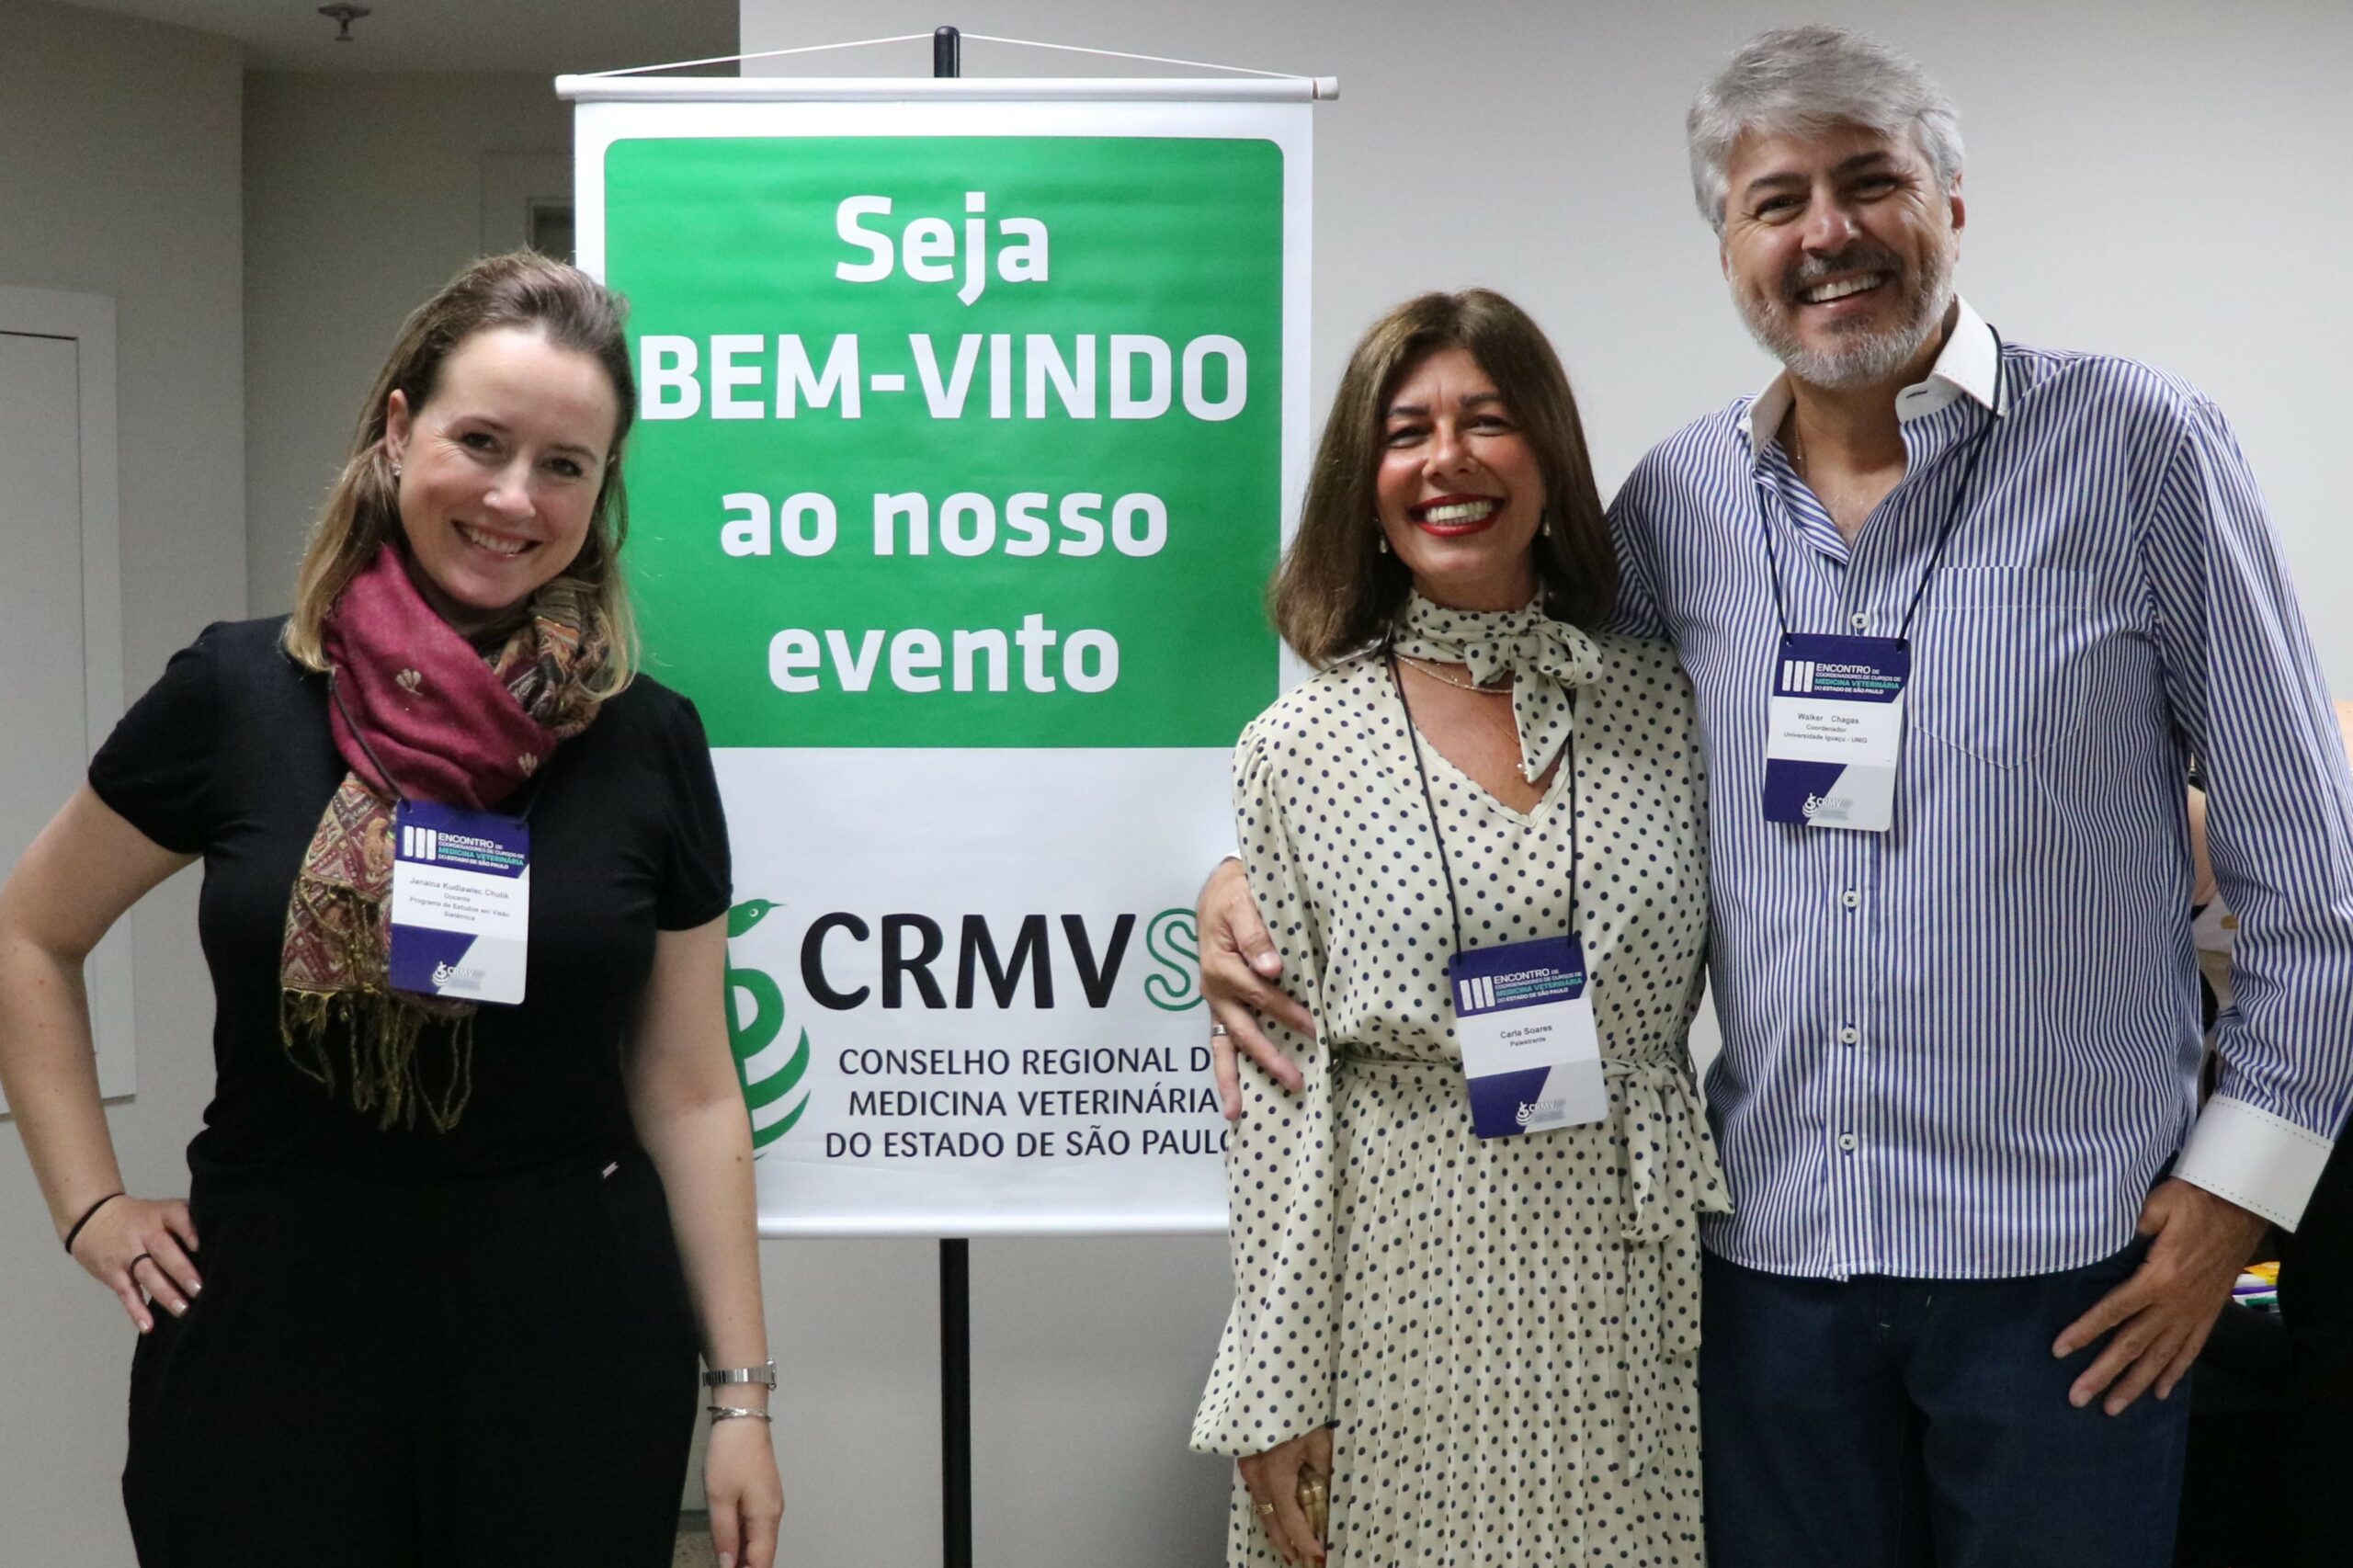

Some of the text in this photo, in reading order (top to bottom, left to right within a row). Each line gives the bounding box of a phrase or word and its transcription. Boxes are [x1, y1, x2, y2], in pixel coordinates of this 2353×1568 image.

[835, 191, 1050, 307] Seja
[640, 333, 1248, 422] BEM-VINDO
[720, 492, 1168, 557] ao nosso
[767, 613, 1120, 693] evento
[1816, 664, 1870, 675] ENCONTRO
[1852, 680, 1899, 689] VETERINÁRIA
[1831, 715, 1859, 724] Chagas
[1783, 732, 1823, 740] Universidade
[1806, 724, 1847, 733] Coordenador
[438, 833, 494, 848] ENCONTRO
[438, 846, 524, 866] MEDICINA VETERINÁRIA
[447, 855, 469, 863] ESTADO
[478, 858, 490, 867] SÃO
[1494, 968, 1550, 984] ENCONTRO
[1496, 978, 1583, 996] MEDICINA VETERINÁRIA
[1500, 1026, 1552, 1039] Carla Soares
[1510, 1037, 1546, 1047] Palestrante
[838, 1046, 1211, 1076] CONSELHO REGIONAL D
[848, 1082, 1219, 1117] MEDICINA VETERINÁRIA
[826, 1131, 872, 1158] DO
[883, 1131, 1005, 1158] ESTADO
[1017, 1131, 1054, 1157] DE
[1065, 1124, 1131, 1156] SÃO
